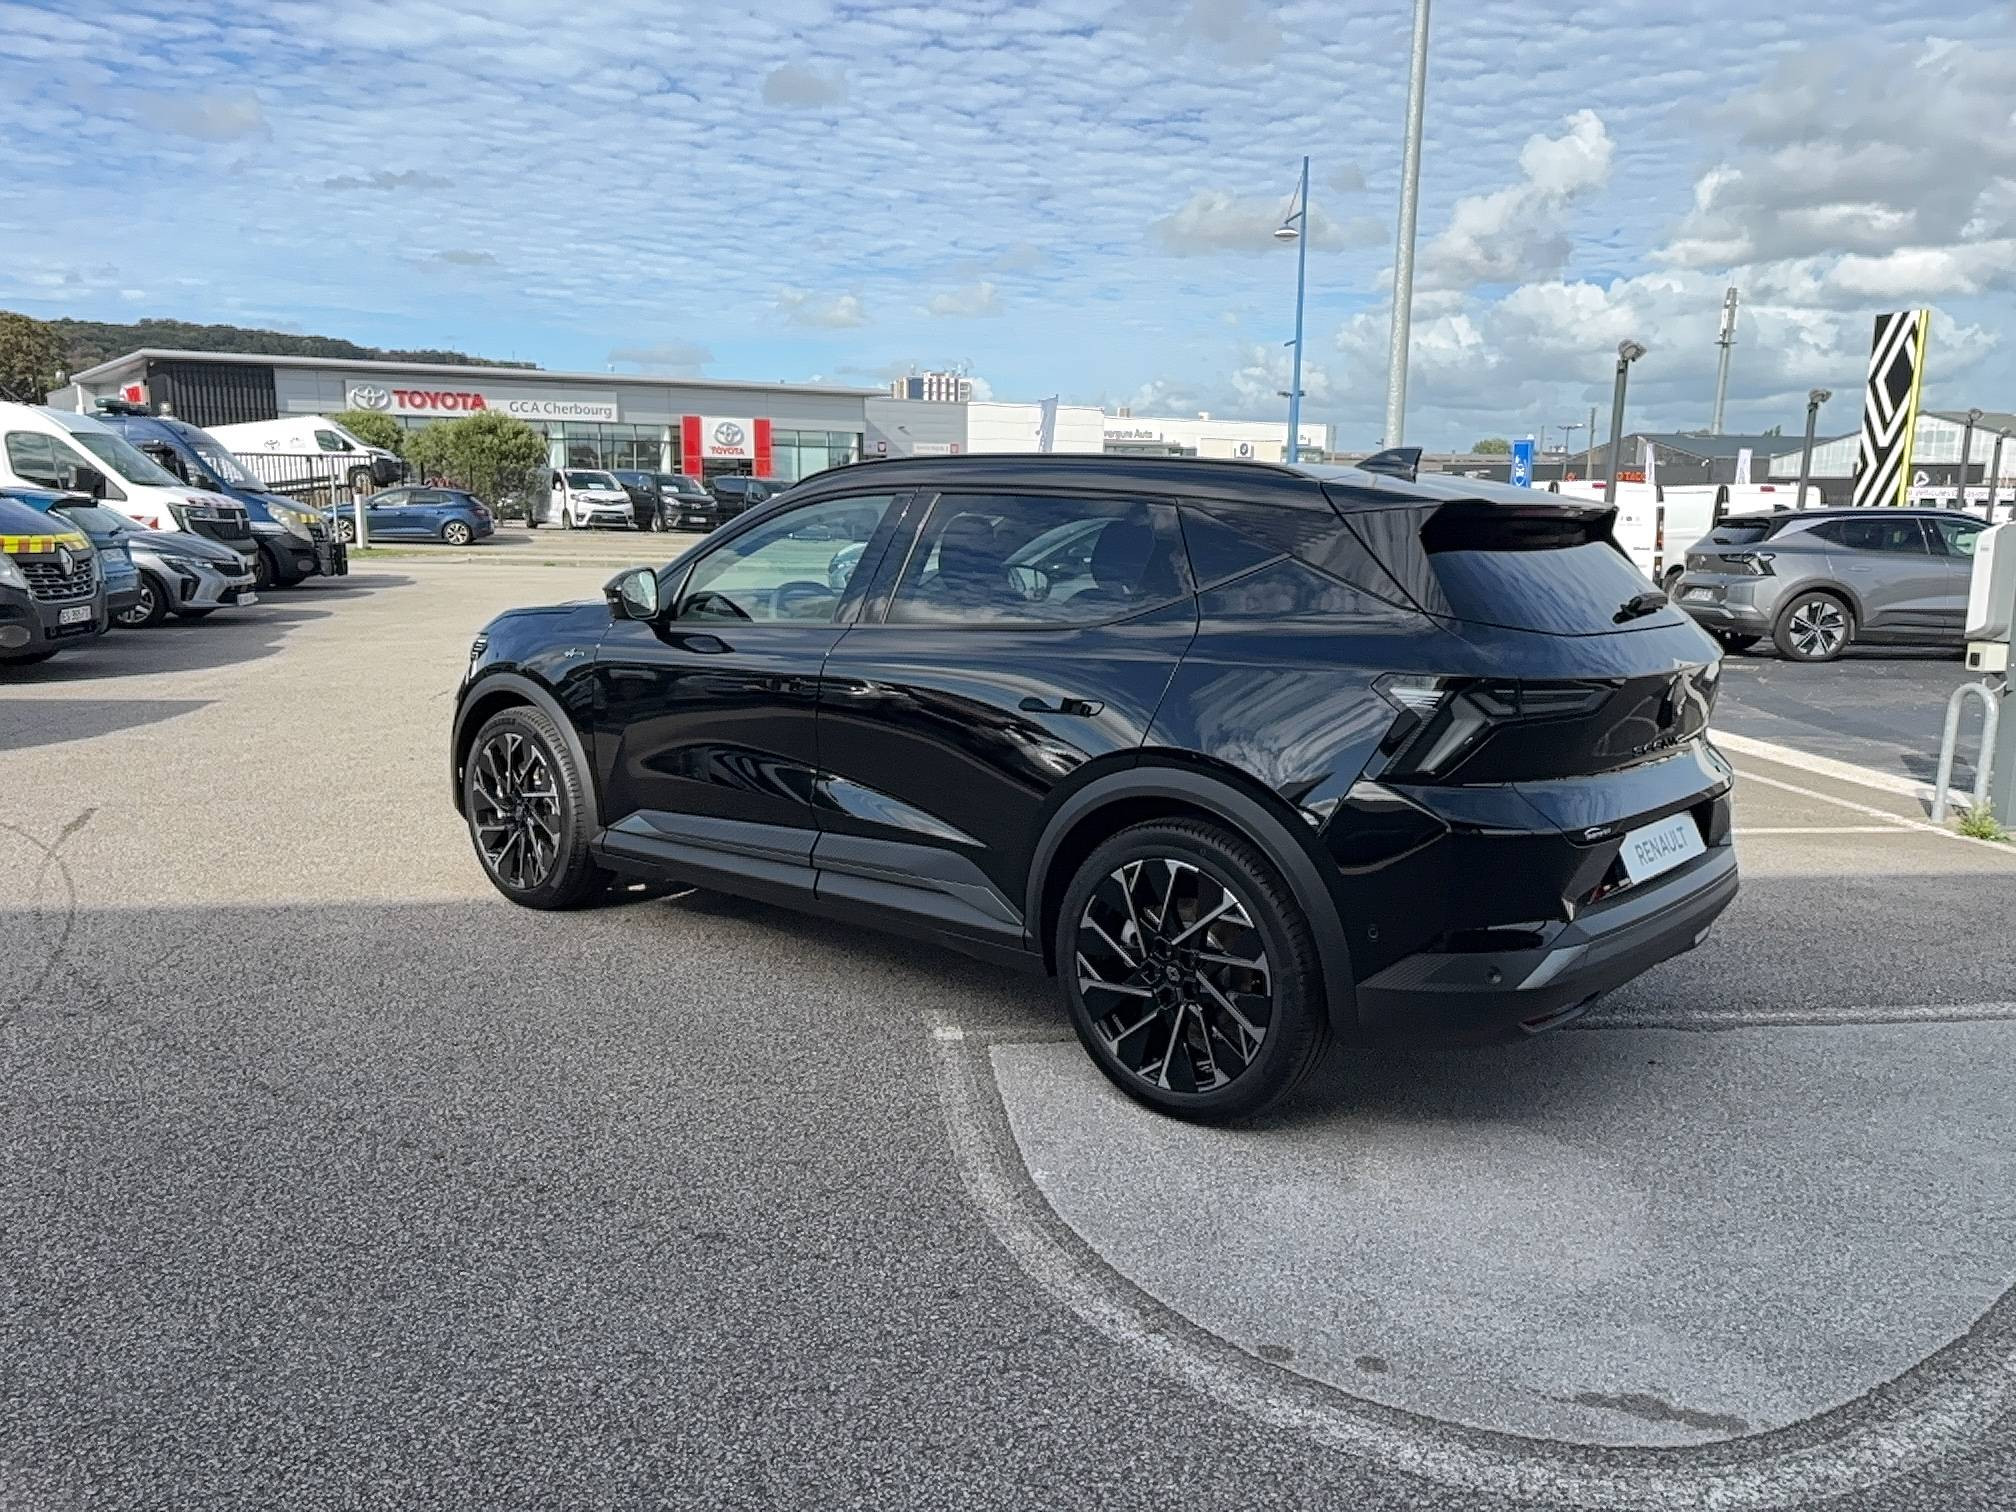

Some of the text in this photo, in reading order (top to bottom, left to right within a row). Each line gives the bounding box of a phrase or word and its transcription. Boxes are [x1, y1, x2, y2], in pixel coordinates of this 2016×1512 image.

[392, 389, 487, 411] TOYOTA
[509, 401, 613, 419] GCA Cherbourg
[711, 446, 745, 455] TOYOTA
[1634, 825, 1689, 866] RENAULT
